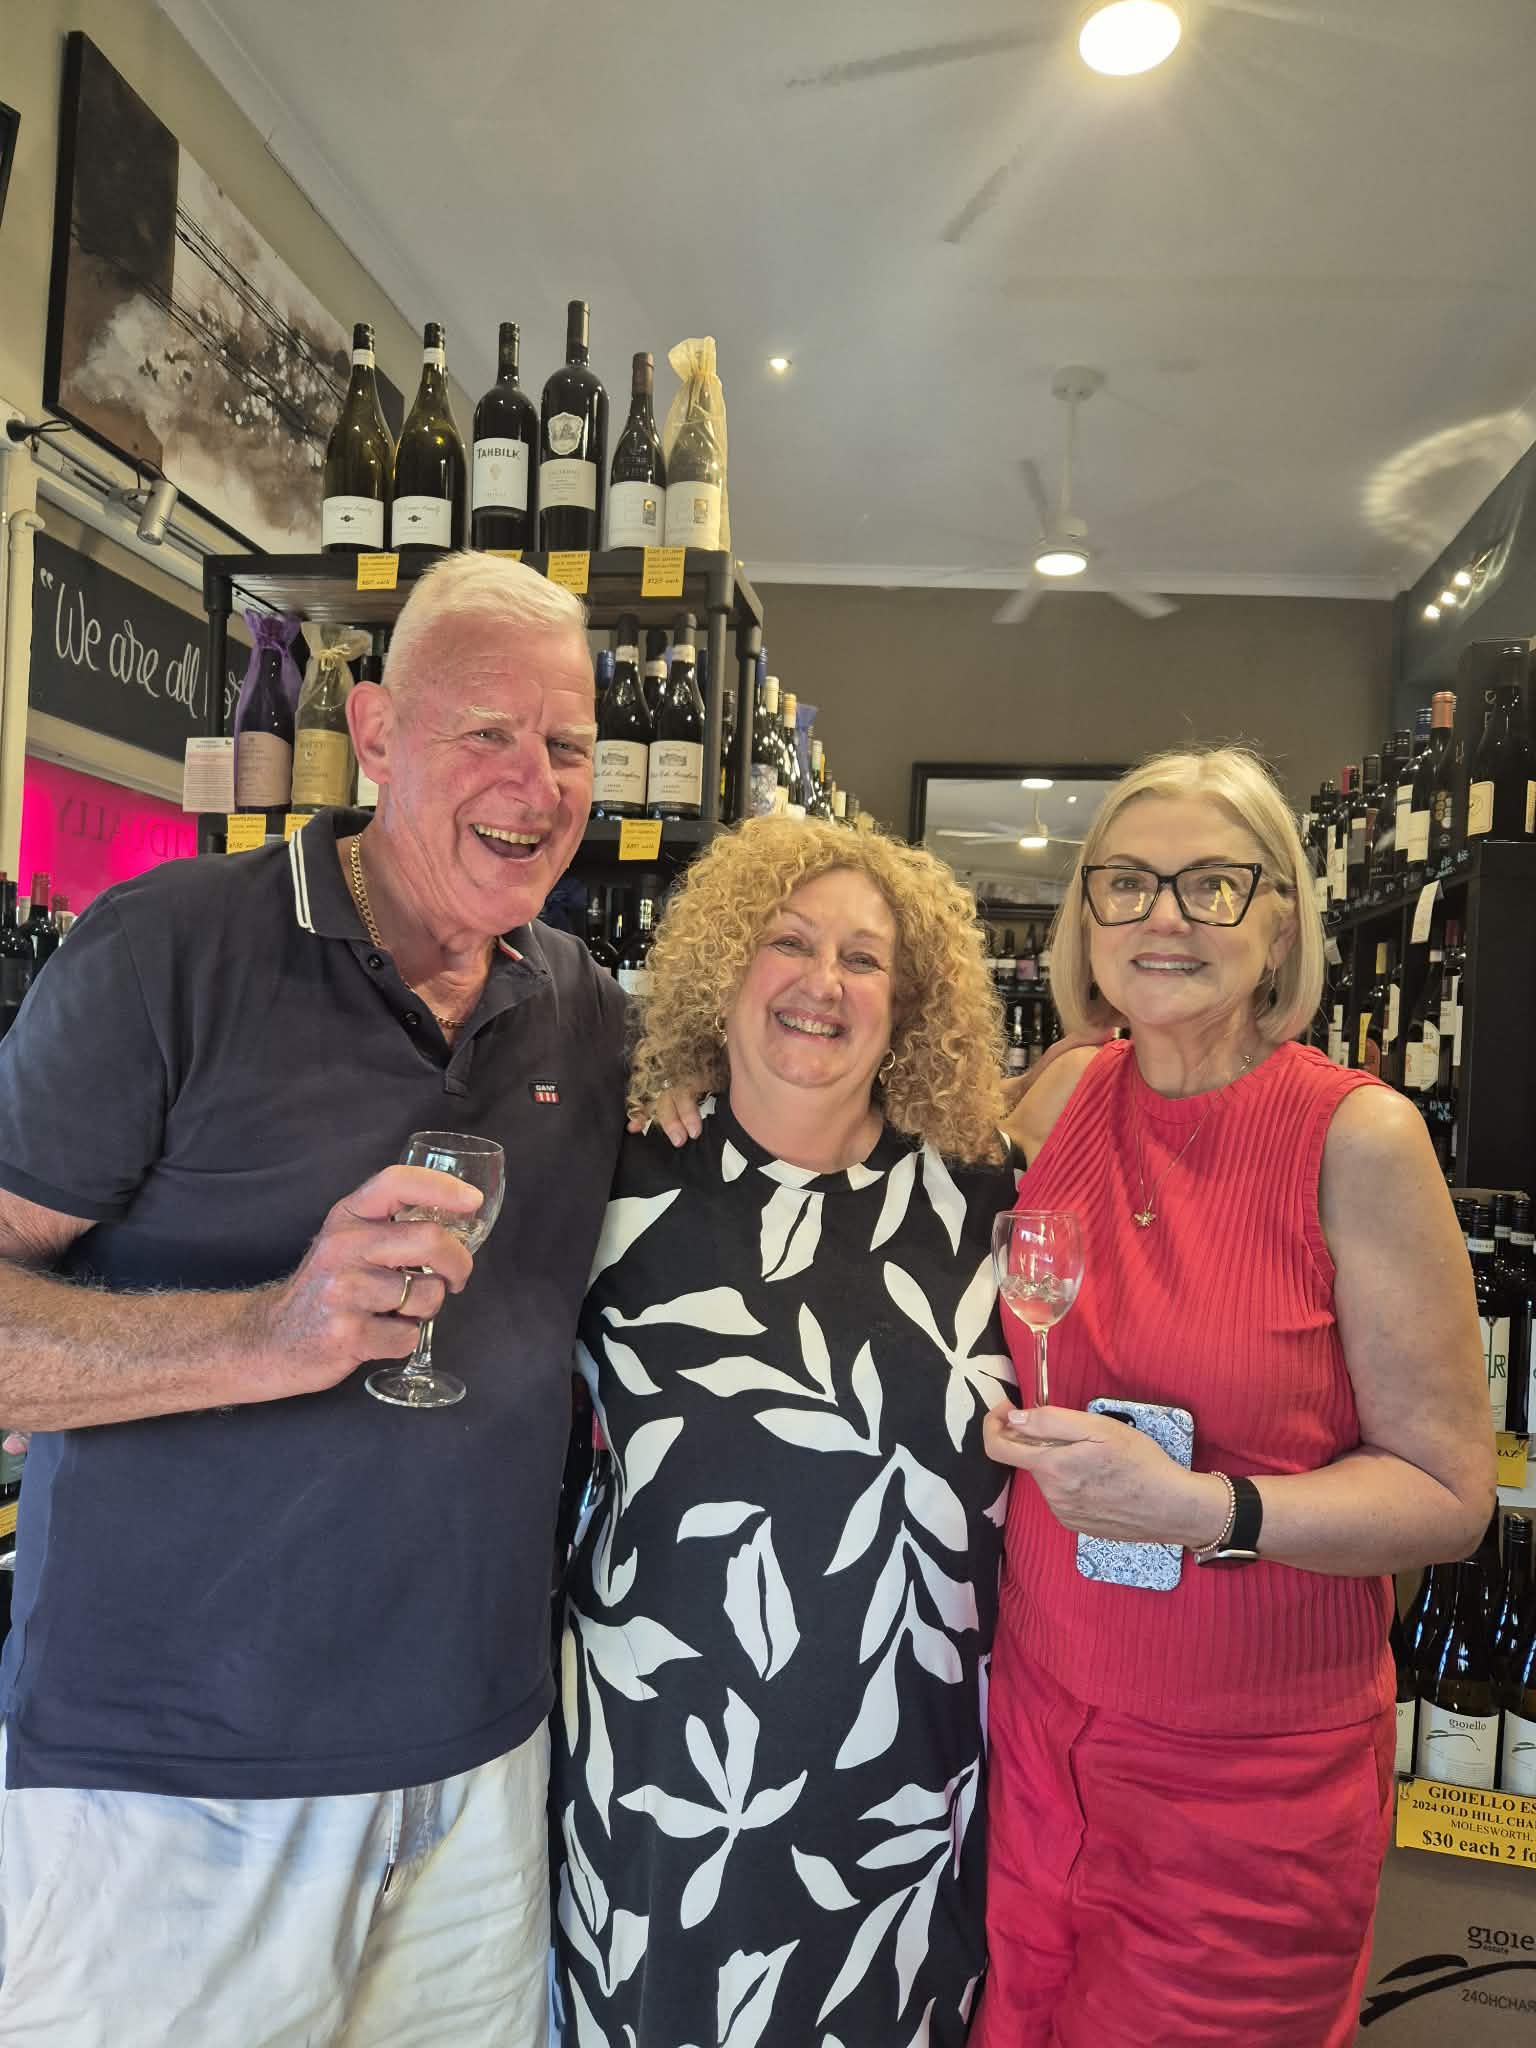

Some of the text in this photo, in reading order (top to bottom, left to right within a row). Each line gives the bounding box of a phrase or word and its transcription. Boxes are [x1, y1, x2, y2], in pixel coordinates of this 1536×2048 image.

[476, 447, 521, 460] TAHBILK
[109, 619, 160, 698] are
[166, 642, 201, 719] all
[1449, 1717, 1487, 1731] gioiello
[1428, 1785, 1516, 1812] GIOIELLO
[1412, 1799, 1536, 1829] 2024 OLD HILL CHA
[1422, 1829, 1454, 1849] $30
[1459, 1839, 1500, 1857] each
[1505, 1845, 1516, 1860] 2
